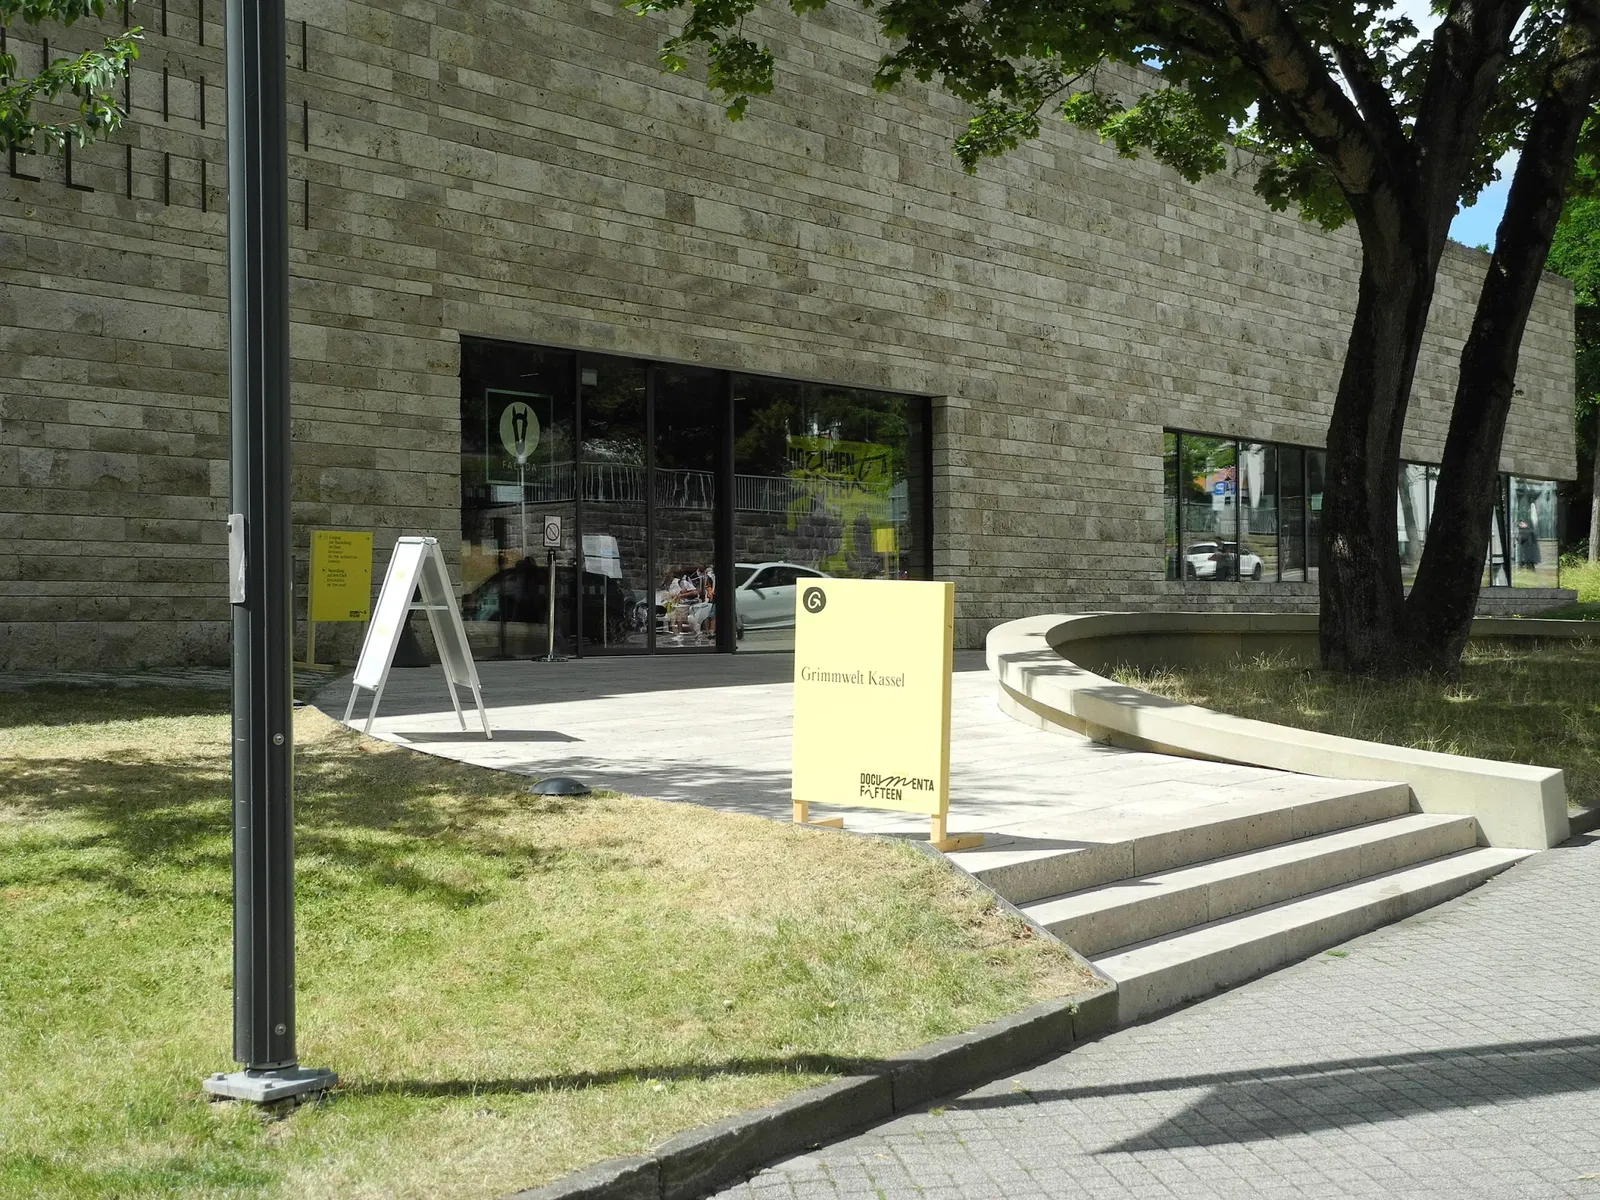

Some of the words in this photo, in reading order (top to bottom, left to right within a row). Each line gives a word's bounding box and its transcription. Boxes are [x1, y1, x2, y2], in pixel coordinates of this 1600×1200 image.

[801, 666, 864, 685] Grimmwelt
[868, 670, 905, 687] Kassel
[860, 772, 935, 792] DOCUMENTA
